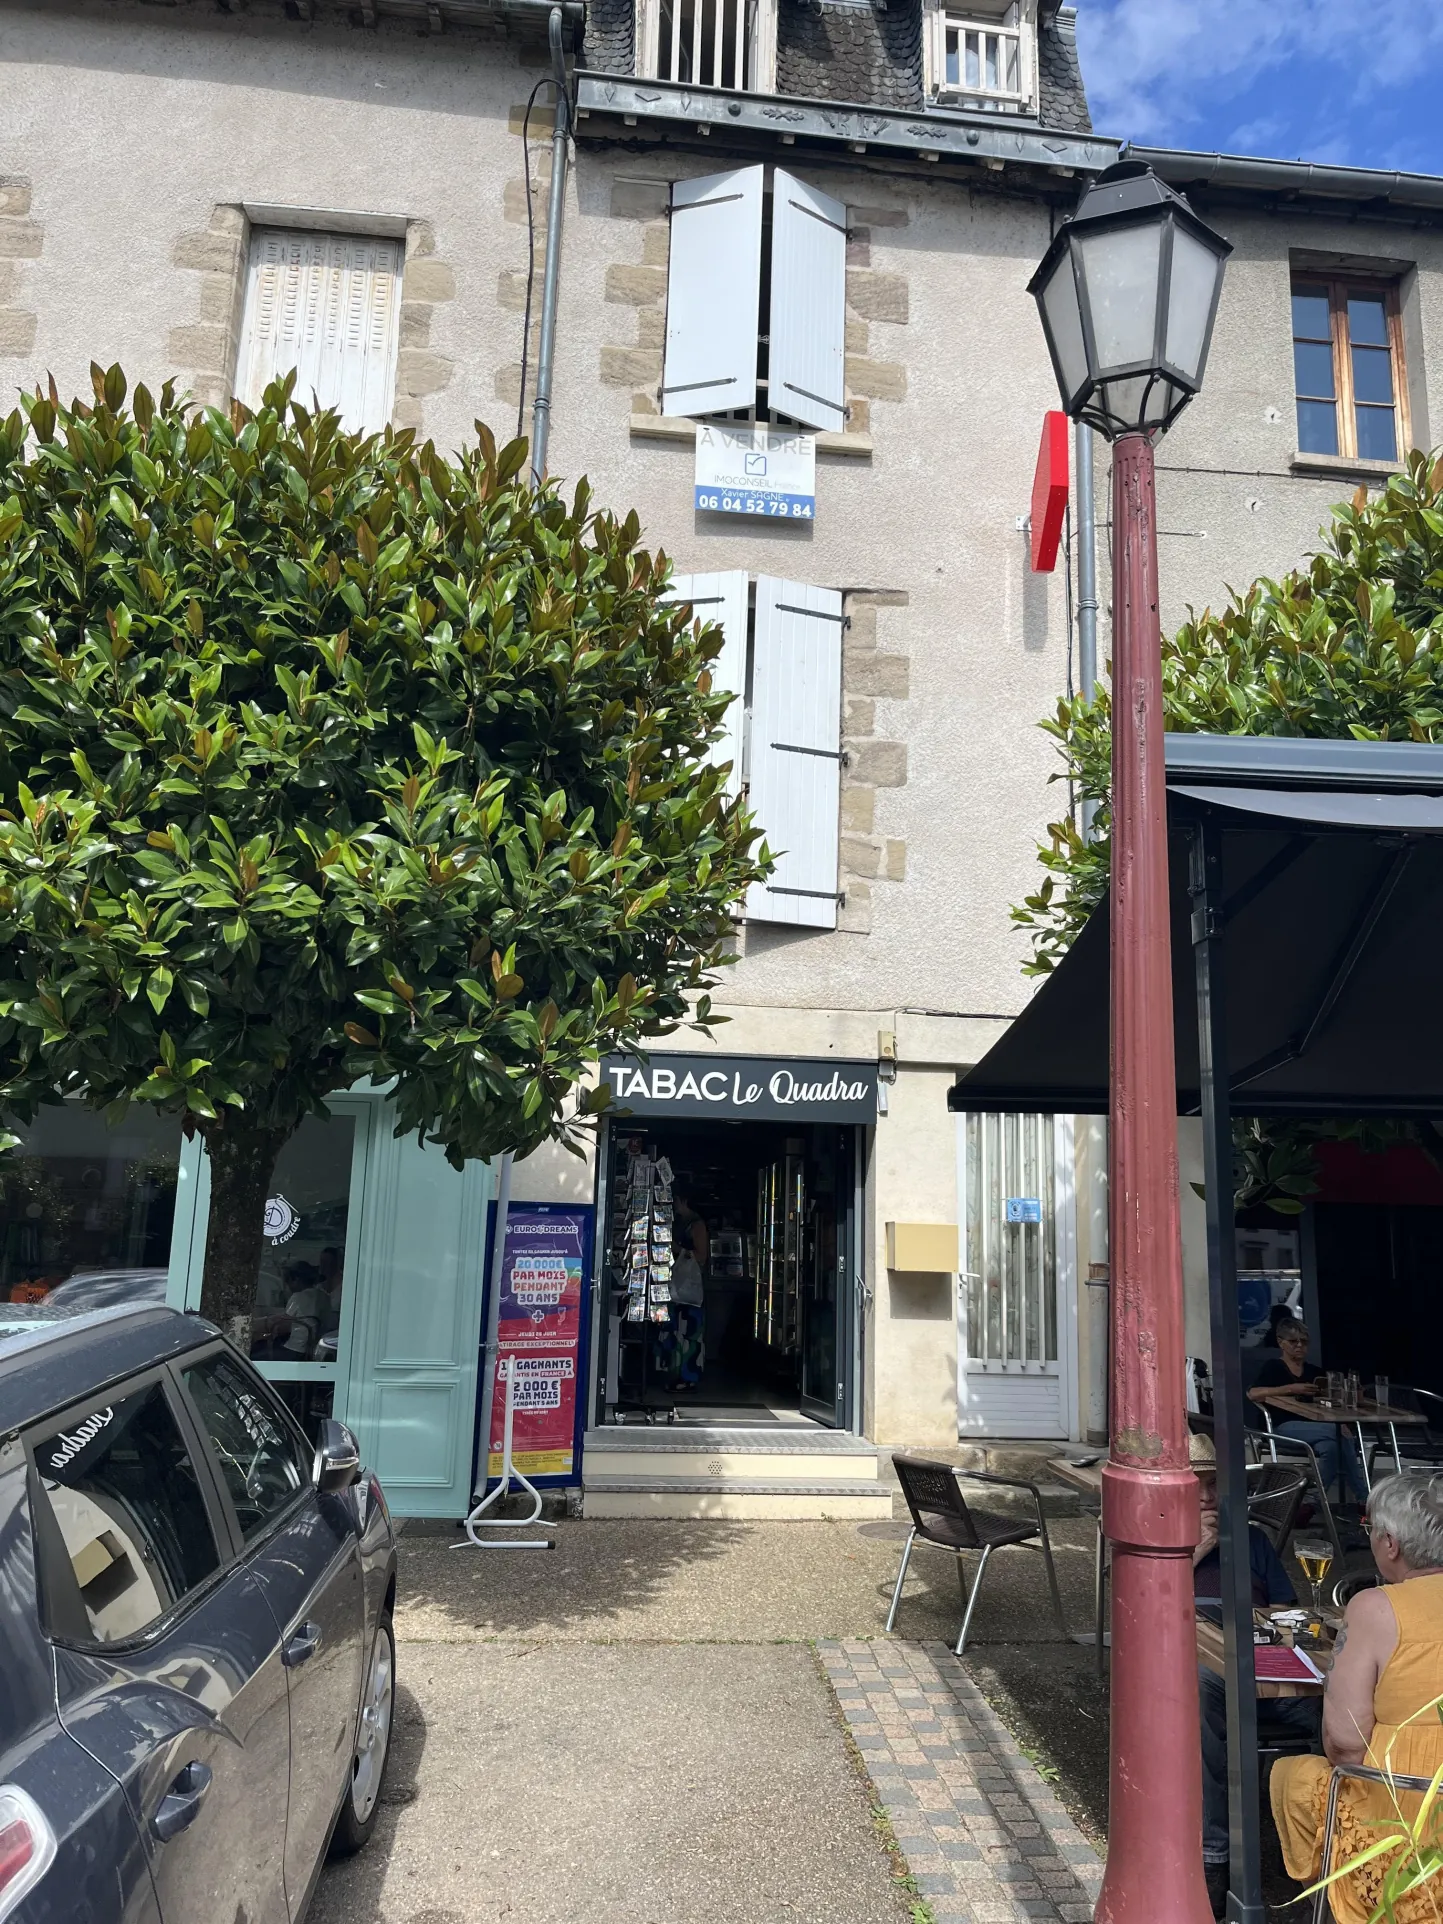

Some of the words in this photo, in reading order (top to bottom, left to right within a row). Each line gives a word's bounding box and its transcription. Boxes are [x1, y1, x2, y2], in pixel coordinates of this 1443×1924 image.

[720, 432, 811, 456] VENDRE
[714, 475, 772, 489] IMOCONSEIL
[721, 488, 749, 498] Xavier
[751, 491, 784, 501] SAGNE
[699, 495, 719, 509] 06
[722, 497, 742, 511] 04
[746, 499, 765, 513] 52
[769, 502, 788, 516] 79
[792, 504, 812, 518] 84
[609, 1067, 728, 1101] TABAC
[732, 1071, 764, 1105] Le
[769, 1070, 869, 1105] Quadra
[271, 1236, 279, 1246] à
[280, 1216, 301, 1243] coudre
[513, 1271, 535, 1280] PAR
[537, 1271, 566, 1280] MOIS
[513, 1282, 564, 1291] PENDANT
[519, 1294, 533, 1302] 30
[536, 1294, 557, 1302] ANS
[516, 1360, 571, 1370] GAGNANTS
[513, 1382, 520, 1392] 2
[523, 1381, 548, 1391] 000
[513, 1392, 531, 1400] PAR
[533, 1391, 558, 1399] MOIS
